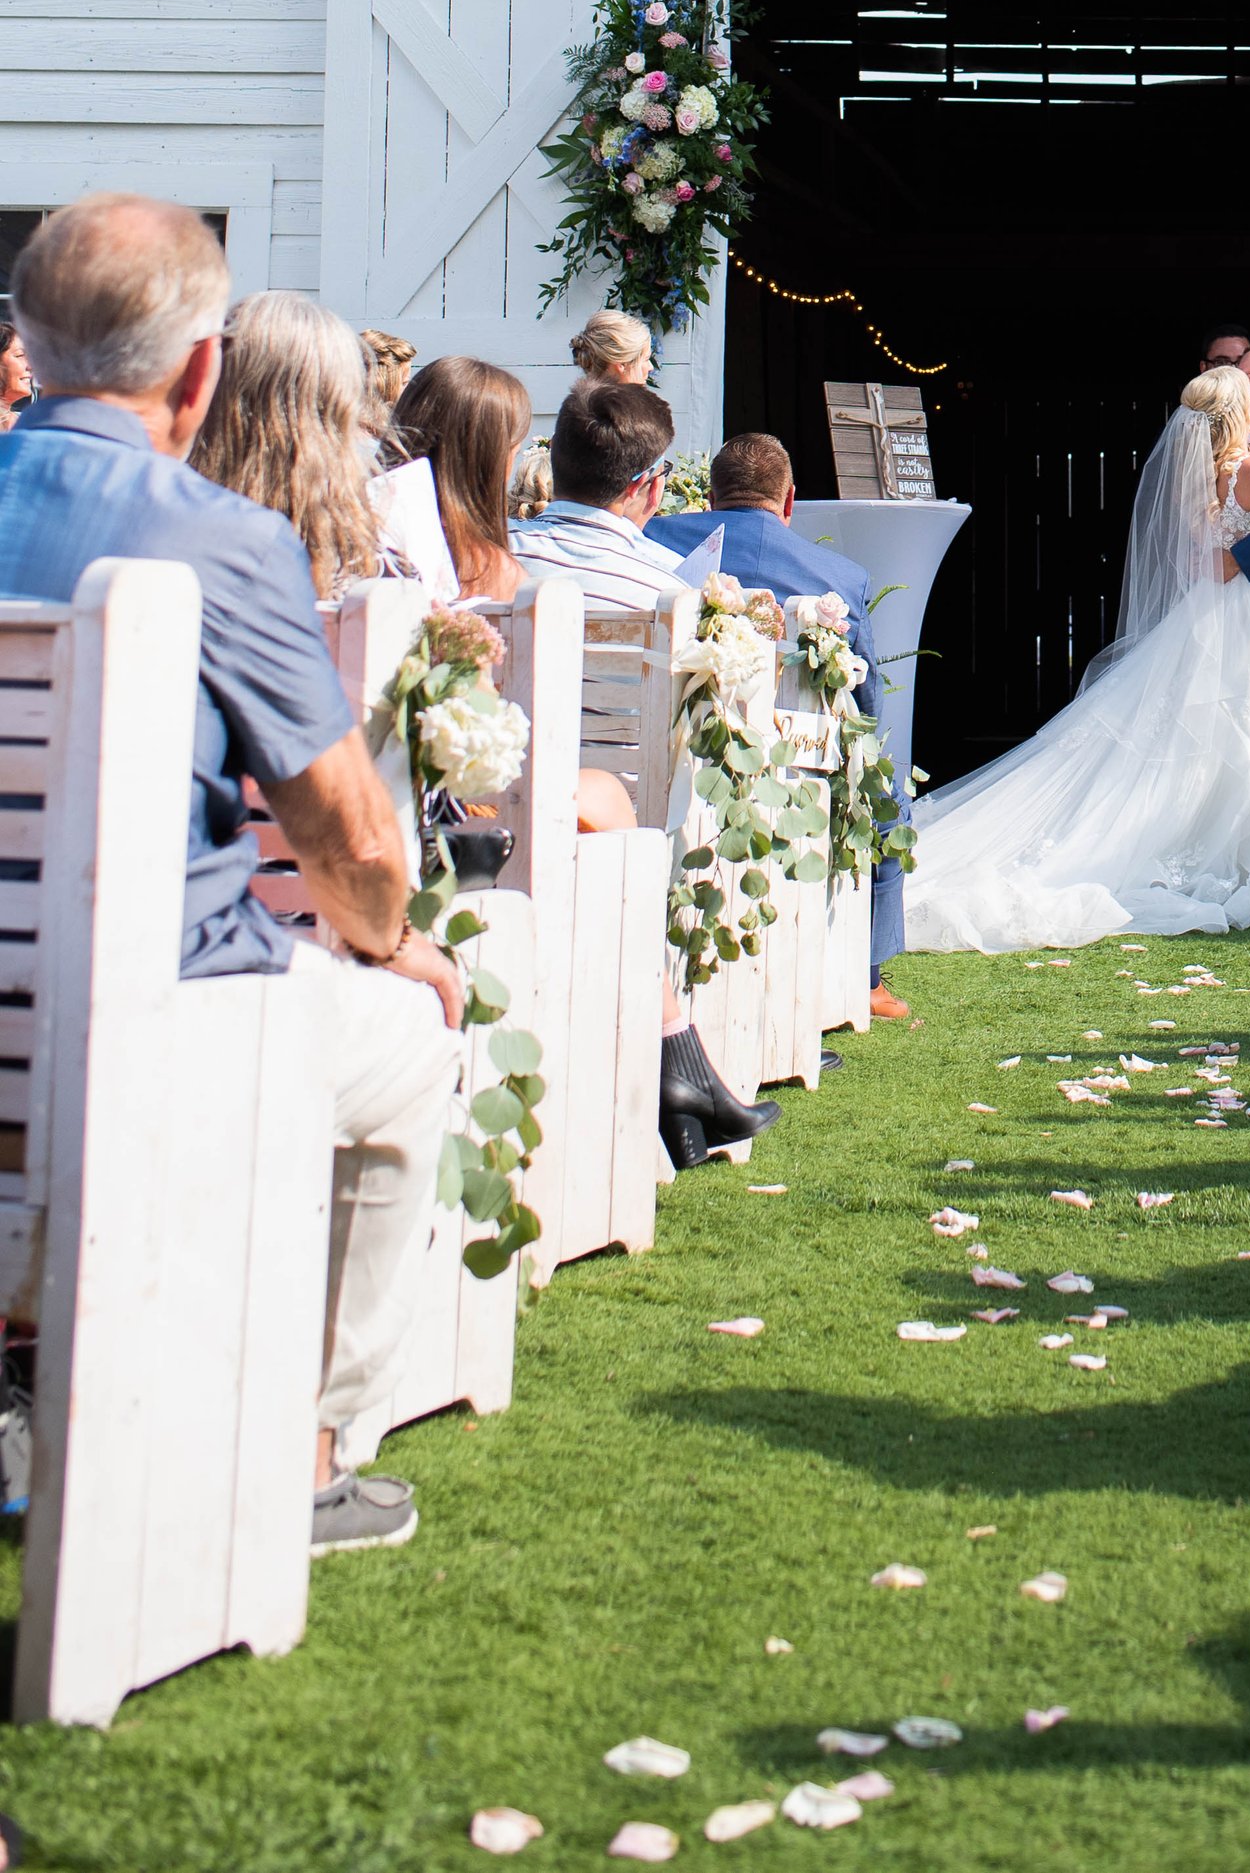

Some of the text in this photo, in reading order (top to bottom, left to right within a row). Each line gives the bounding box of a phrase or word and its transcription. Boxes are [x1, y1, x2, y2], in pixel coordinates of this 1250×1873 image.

[890, 432, 928, 447] A cord of
[898, 457, 918, 466] is not
[897, 463, 930, 479] easily
[898, 481, 932, 494] BROKEN
